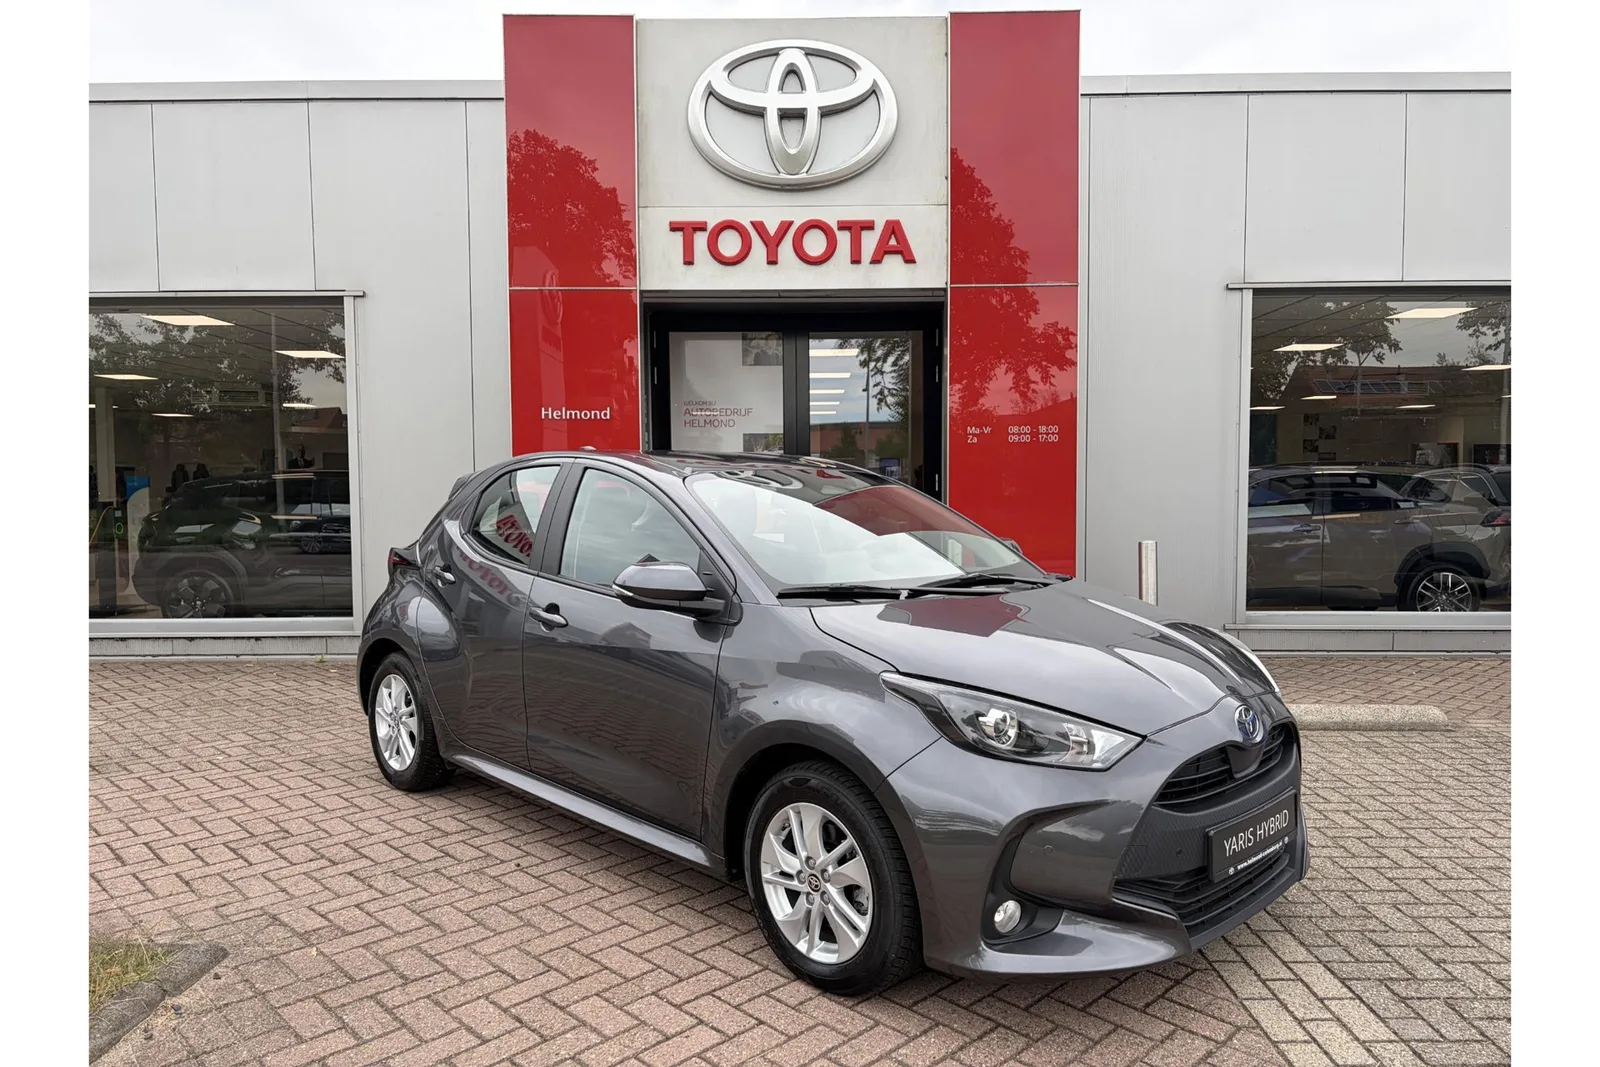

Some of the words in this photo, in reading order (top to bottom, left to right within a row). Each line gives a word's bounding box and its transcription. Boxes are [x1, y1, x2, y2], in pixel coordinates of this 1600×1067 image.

[669, 218, 917, 266] TOYOTA
[541, 407, 611, 420] Helmond
[684, 407, 753, 417] AUTOBEDRIJF
[684, 418, 736, 428] HELMOND
[967, 426, 992, 434] Ma-Vr
[1008, 426, 1031, 434] 08:00
[1038, 425, 1059, 433] 18:00
[967, 435, 978, 443] Za
[1008, 434, 1031, 443] 09:00
[1038, 434, 1059, 442] 17:00
[1223, 828, 1254, 857] YARIS
[1257, 809, 1289, 842] HYBRID
